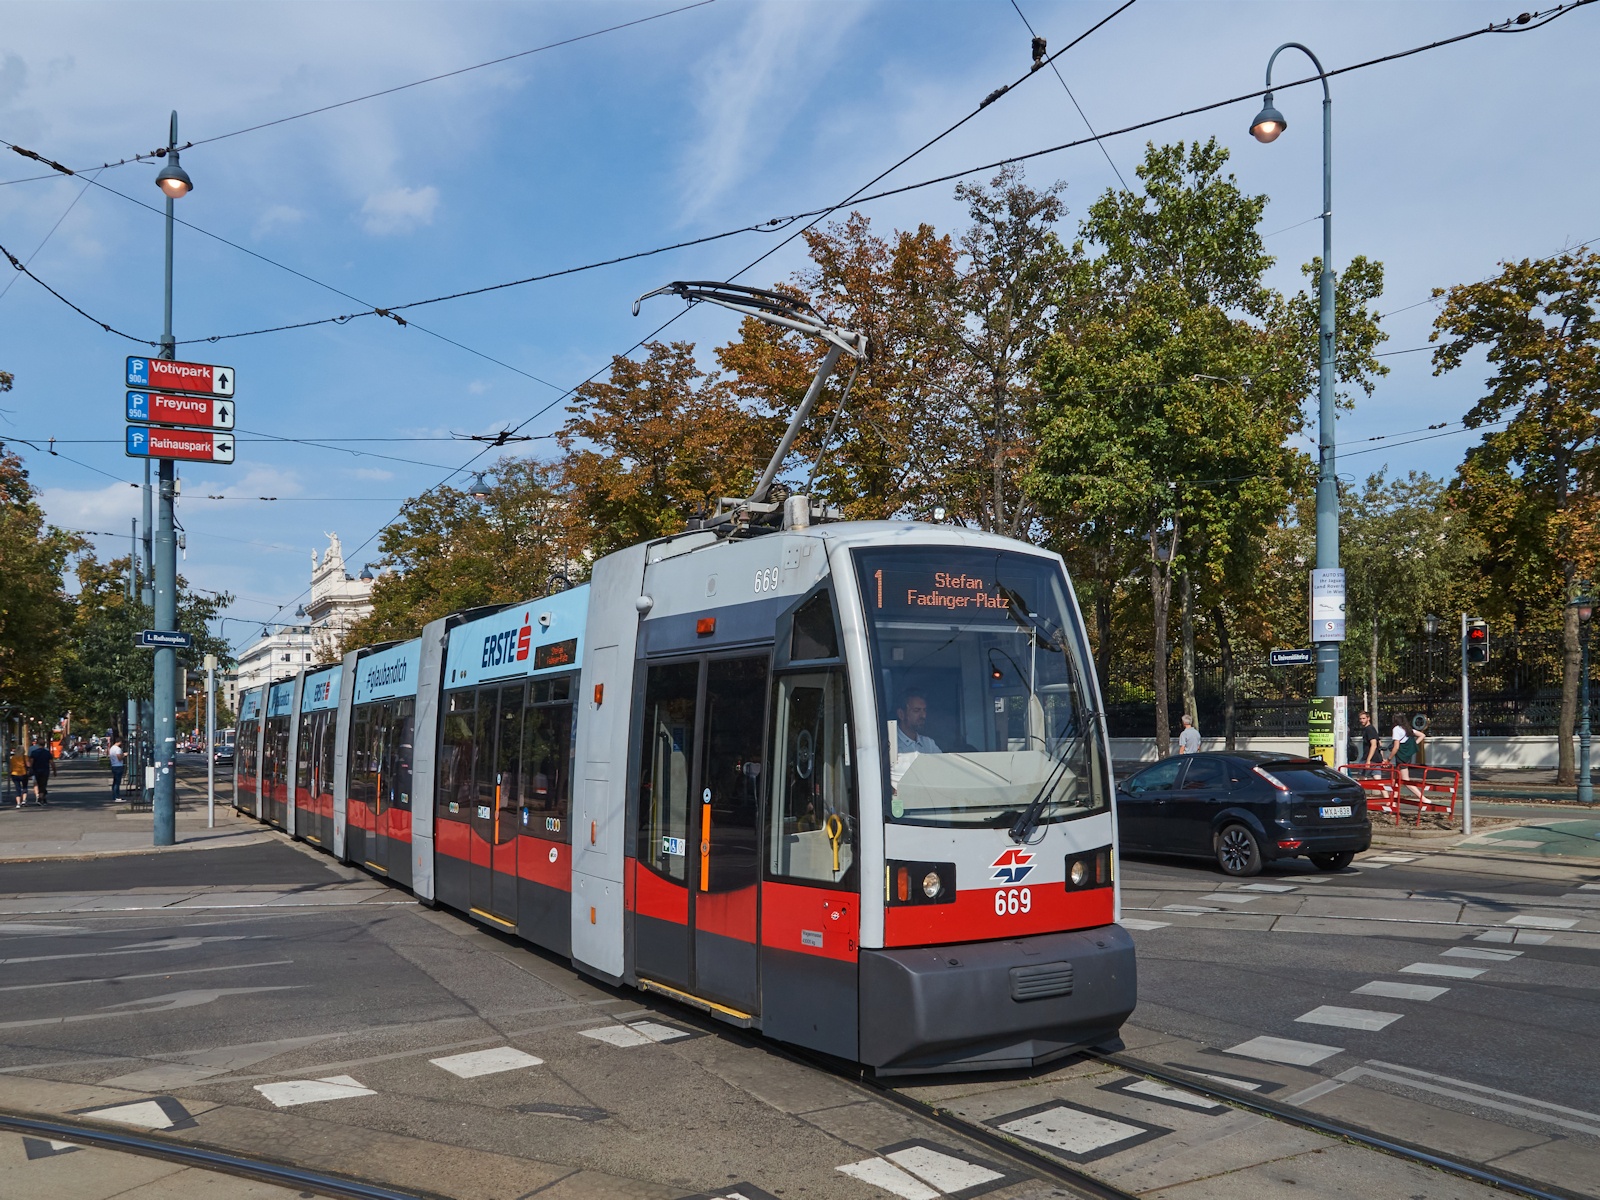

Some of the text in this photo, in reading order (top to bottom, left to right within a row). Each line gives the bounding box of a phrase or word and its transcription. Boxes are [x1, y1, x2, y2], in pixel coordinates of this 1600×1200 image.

[152, 361, 210, 378] Votivpark
[155, 396, 207, 413] Freyung
[150, 437, 211, 452] Rathauspark
[754, 566, 779, 593] 669
[874, 569, 883, 609] 1
[935, 572, 983, 590] Stefan
[907, 589, 1010, 610] Fadinger-Platz
[481, 628, 518, 668] ERSTE
[995, 887, 1031, 916] 669
